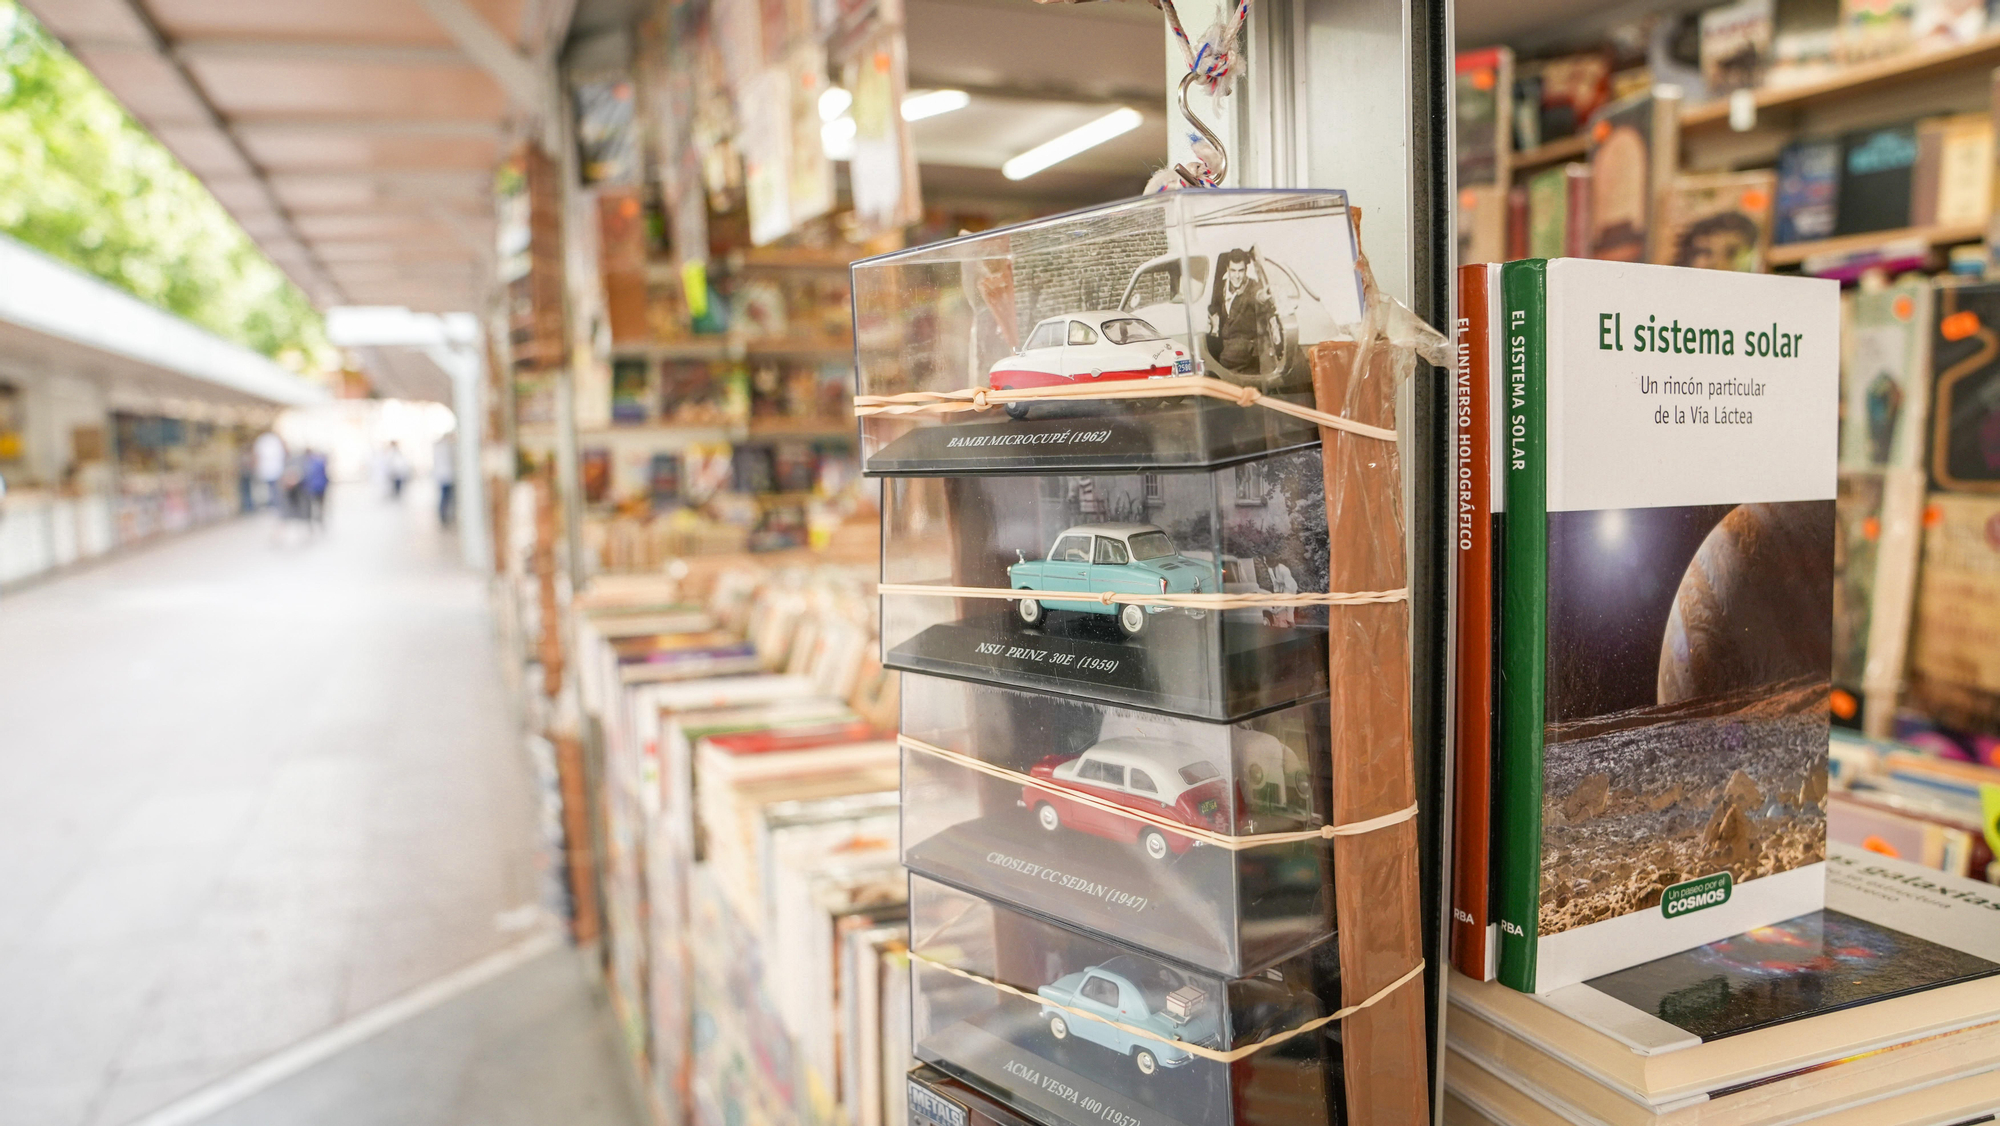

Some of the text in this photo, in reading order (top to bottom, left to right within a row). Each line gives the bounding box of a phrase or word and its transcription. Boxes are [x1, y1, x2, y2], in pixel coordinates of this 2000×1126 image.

[1599, 312, 1803, 358] El sistema solar
[1512, 310, 1525, 470] EL SISTEMA SOLAR
[1641, 375, 1766, 400] Un rincón particular
[1654, 405, 1753, 424] de la Vía Láctea
[947, 429, 1112, 448] BAMBI MICROCUPÉ (1962)
[1458, 318, 1475, 550] EL UNIVERSO HOLOGRÁFICO
[975, 642, 1119, 674] NSU PRINZ 30E (1959)
[986, 851, 1148, 912] CROSLEY CC SEDAN (1947)
[1668, 877, 1725, 900] Un paseo por el
[1668, 888, 1725, 914] COSMOS
[1454, 907, 1475, 925] RBA
[1501, 919, 1524, 937] RBA
[1003, 1060, 1040, 1085] ACMA
[1041, 1076, 1079, 1104] VESPA
[1080, 1096, 1102, 1114] 400
